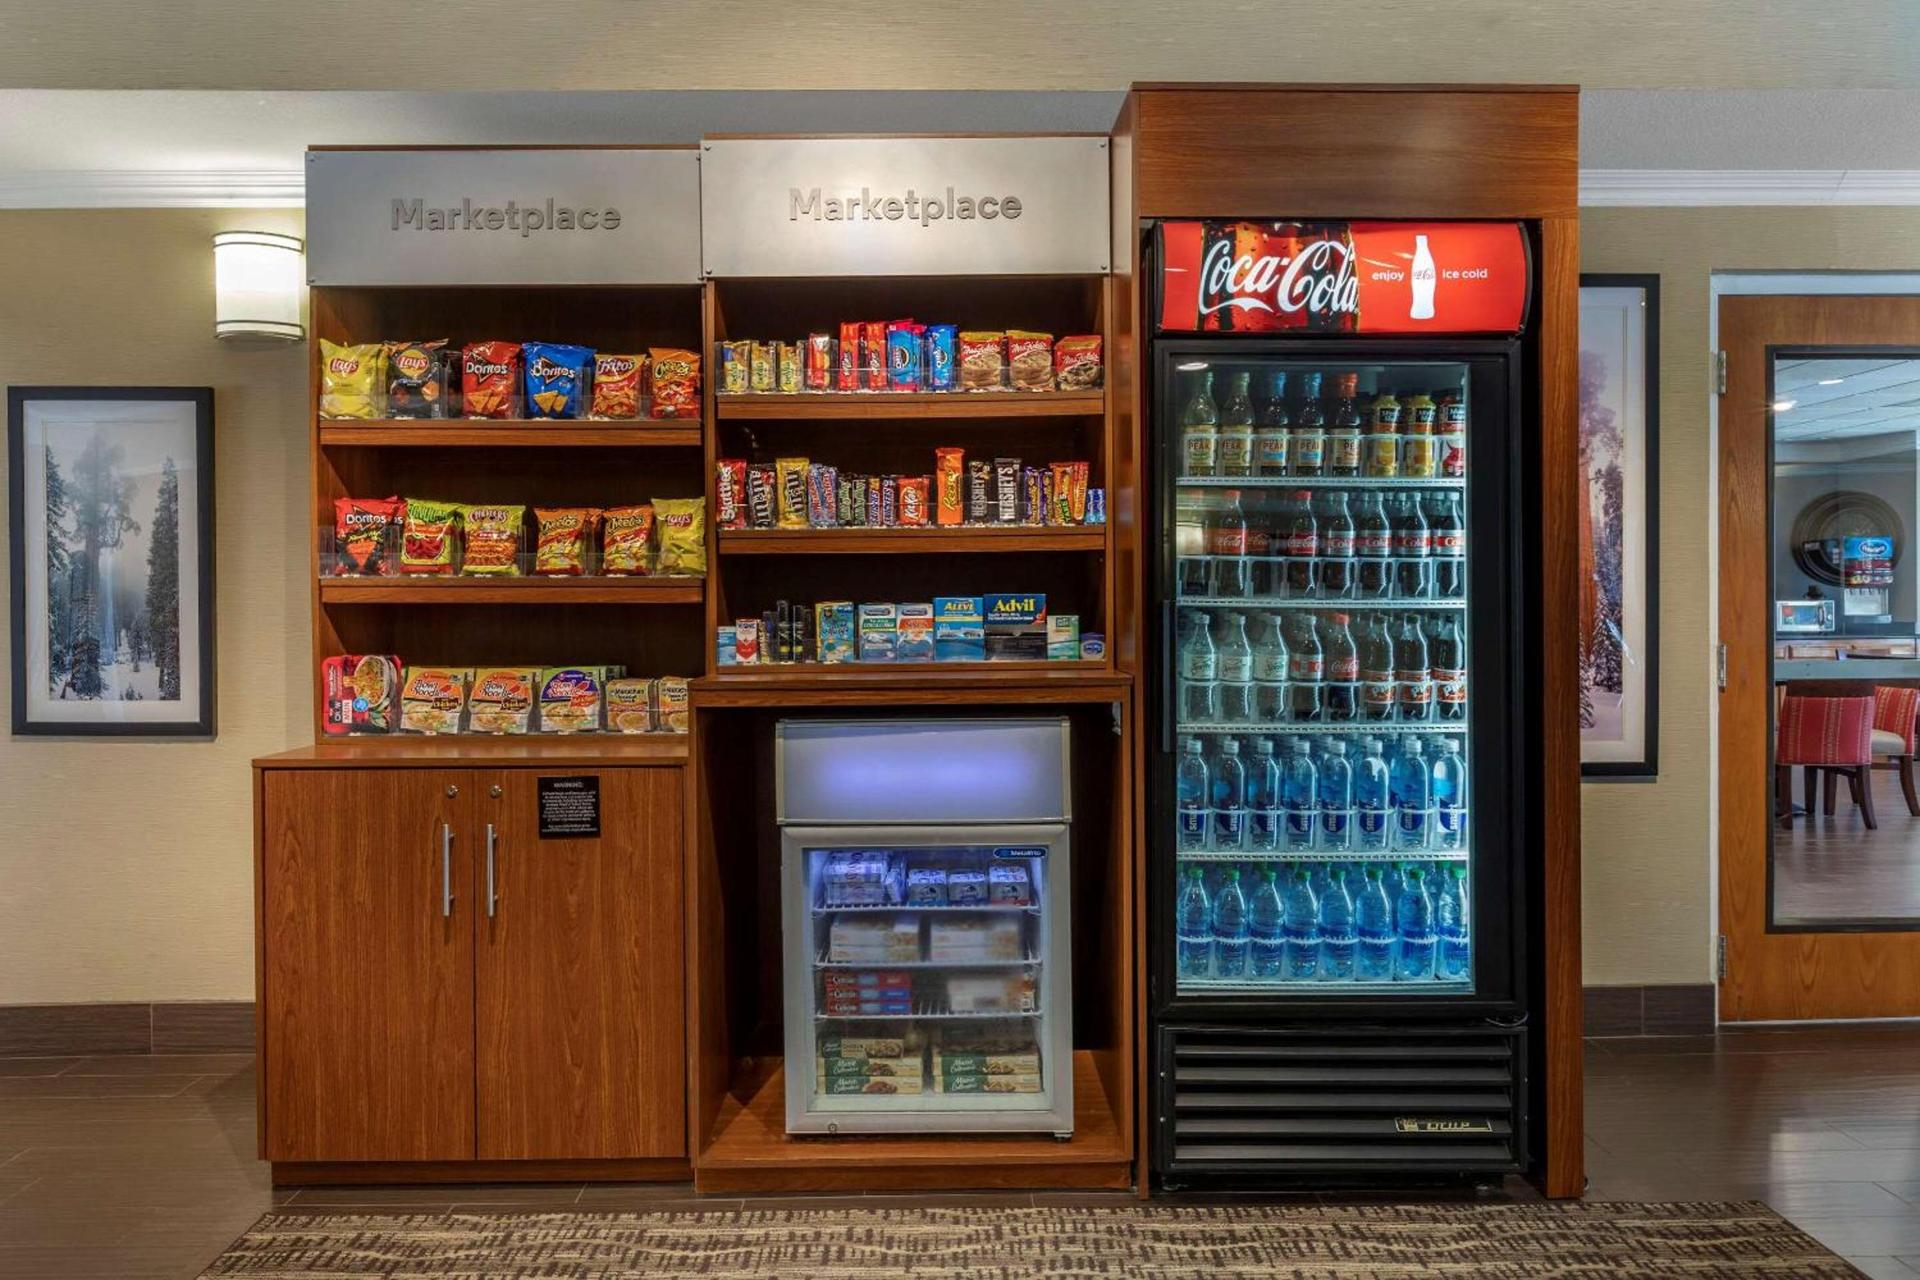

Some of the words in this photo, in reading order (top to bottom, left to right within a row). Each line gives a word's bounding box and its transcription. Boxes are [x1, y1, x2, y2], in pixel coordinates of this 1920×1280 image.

[789, 188, 1022, 227] Marketplace
[391, 198, 621, 236] Marketplace
[1200, 240, 1361, 314] Coca-Cola
[1372, 270, 1404, 281] enjoy
[1462, 268, 1488, 279] cold
[331, 358, 358, 375] Lay's
[400, 356, 427, 369] Lay's
[466, 361, 508, 375] Doritos
[531, 359, 576, 379] Doritos
[598, 358, 634, 374] Fritos
[720, 466, 735, 521] Skittles
[971, 471, 986, 516] HERSHEY'S
[998, 466, 1015, 520] HERSHEY'S
[346, 513, 387, 525] Doritos
[666, 513, 691, 528] Lay's
[993, 598, 1035, 612] Advil
